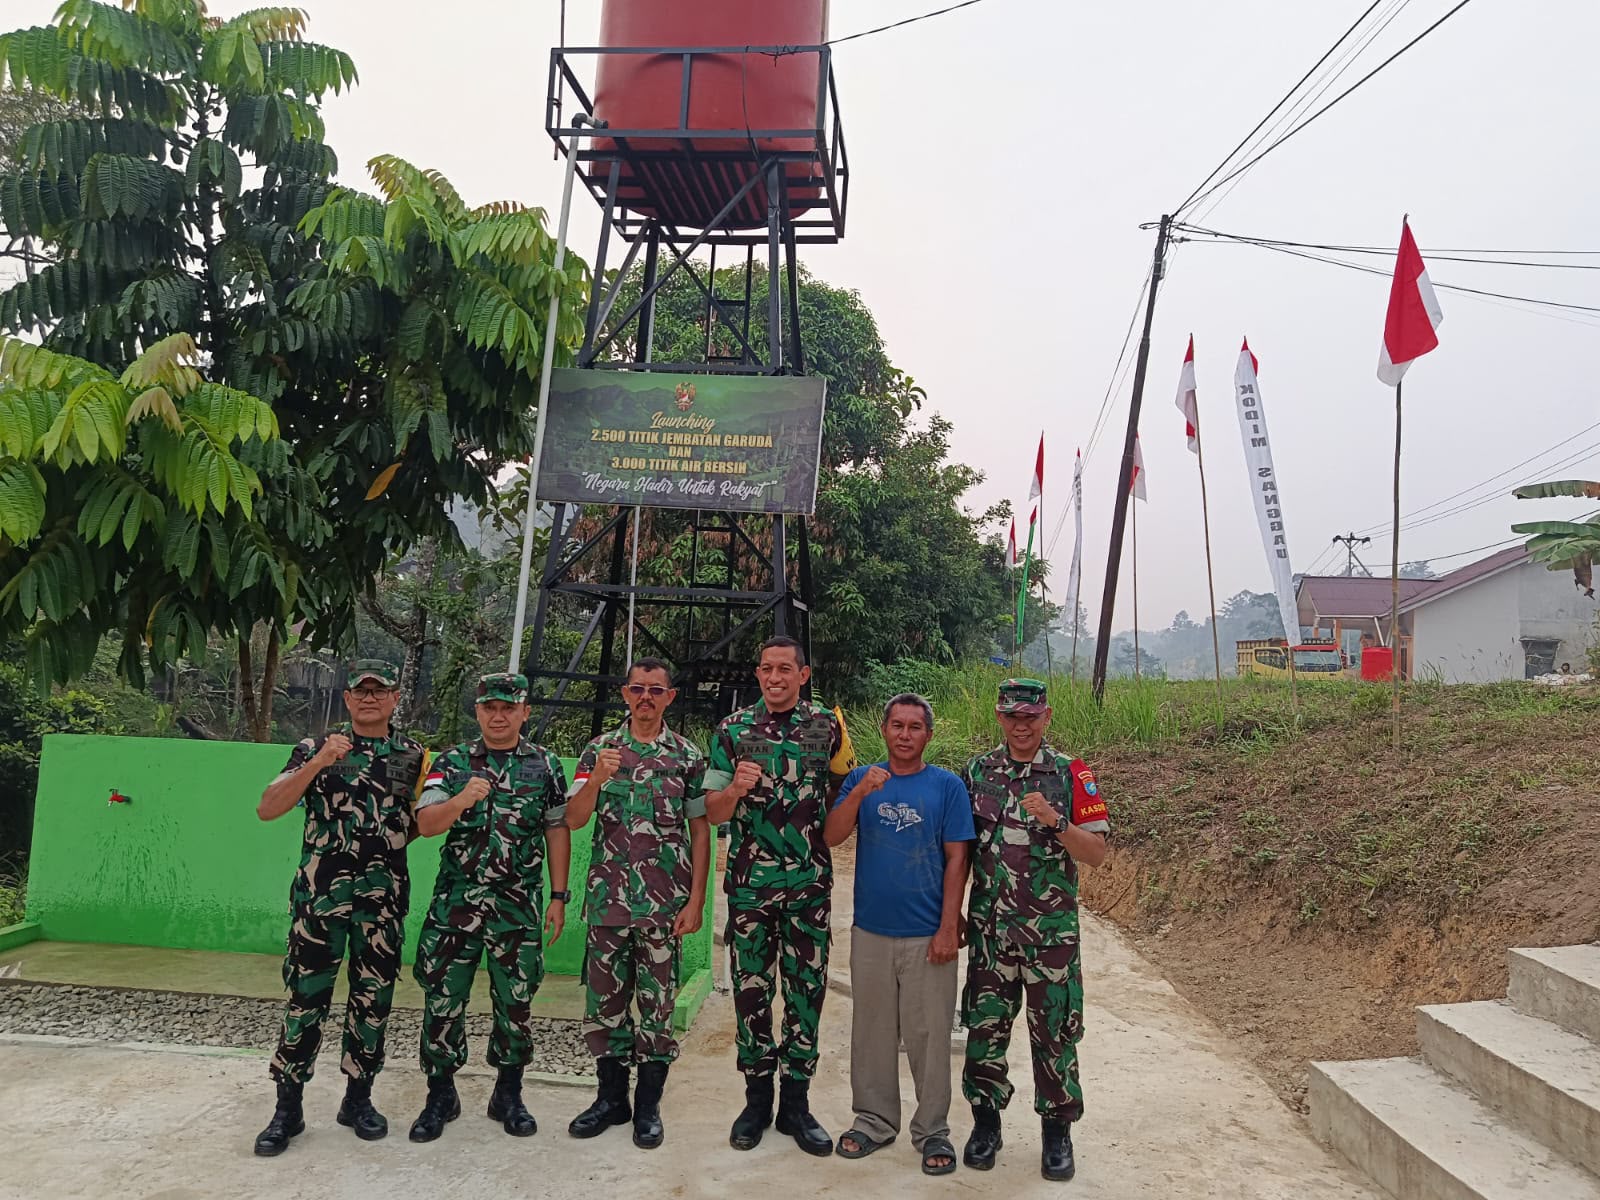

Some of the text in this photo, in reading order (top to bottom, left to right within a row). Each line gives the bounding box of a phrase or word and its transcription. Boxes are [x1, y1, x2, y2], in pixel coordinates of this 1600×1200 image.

[650, 411, 716, 435] Launching
[590, 429, 773, 448] 2.500 TITIK JEMBATAN GARUDA
[669, 446, 692, 458] DAN
[611, 457, 747, 474] 3.000 TITIK AIR BERSIH
[634, 476, 674, 495] Hadir
[678, 477, 716, 496] Untuk
